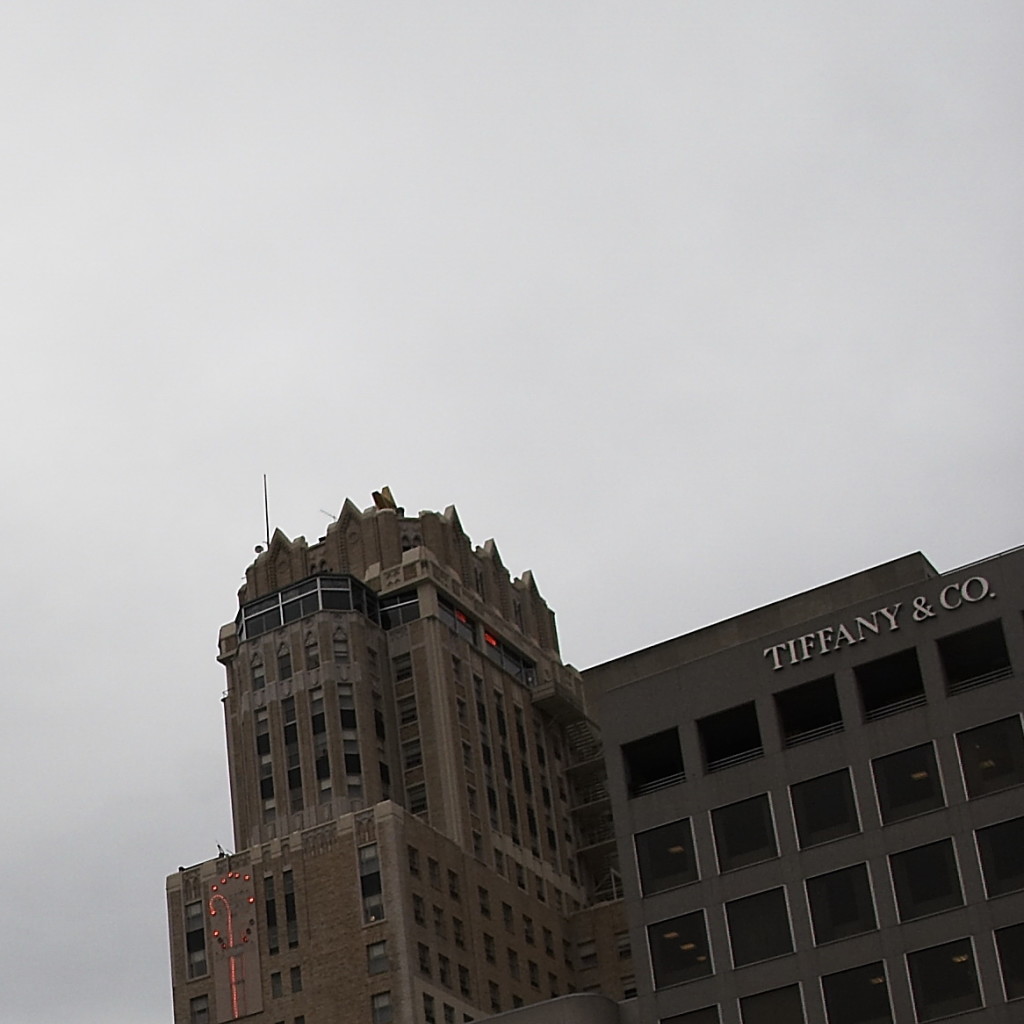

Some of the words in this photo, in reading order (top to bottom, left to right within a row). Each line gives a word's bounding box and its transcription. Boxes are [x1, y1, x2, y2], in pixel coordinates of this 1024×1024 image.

[763, 602, 903, 671] TIFFANY
[912, 596, 937, 622] &
[939, 576, 997, 610] CO.
